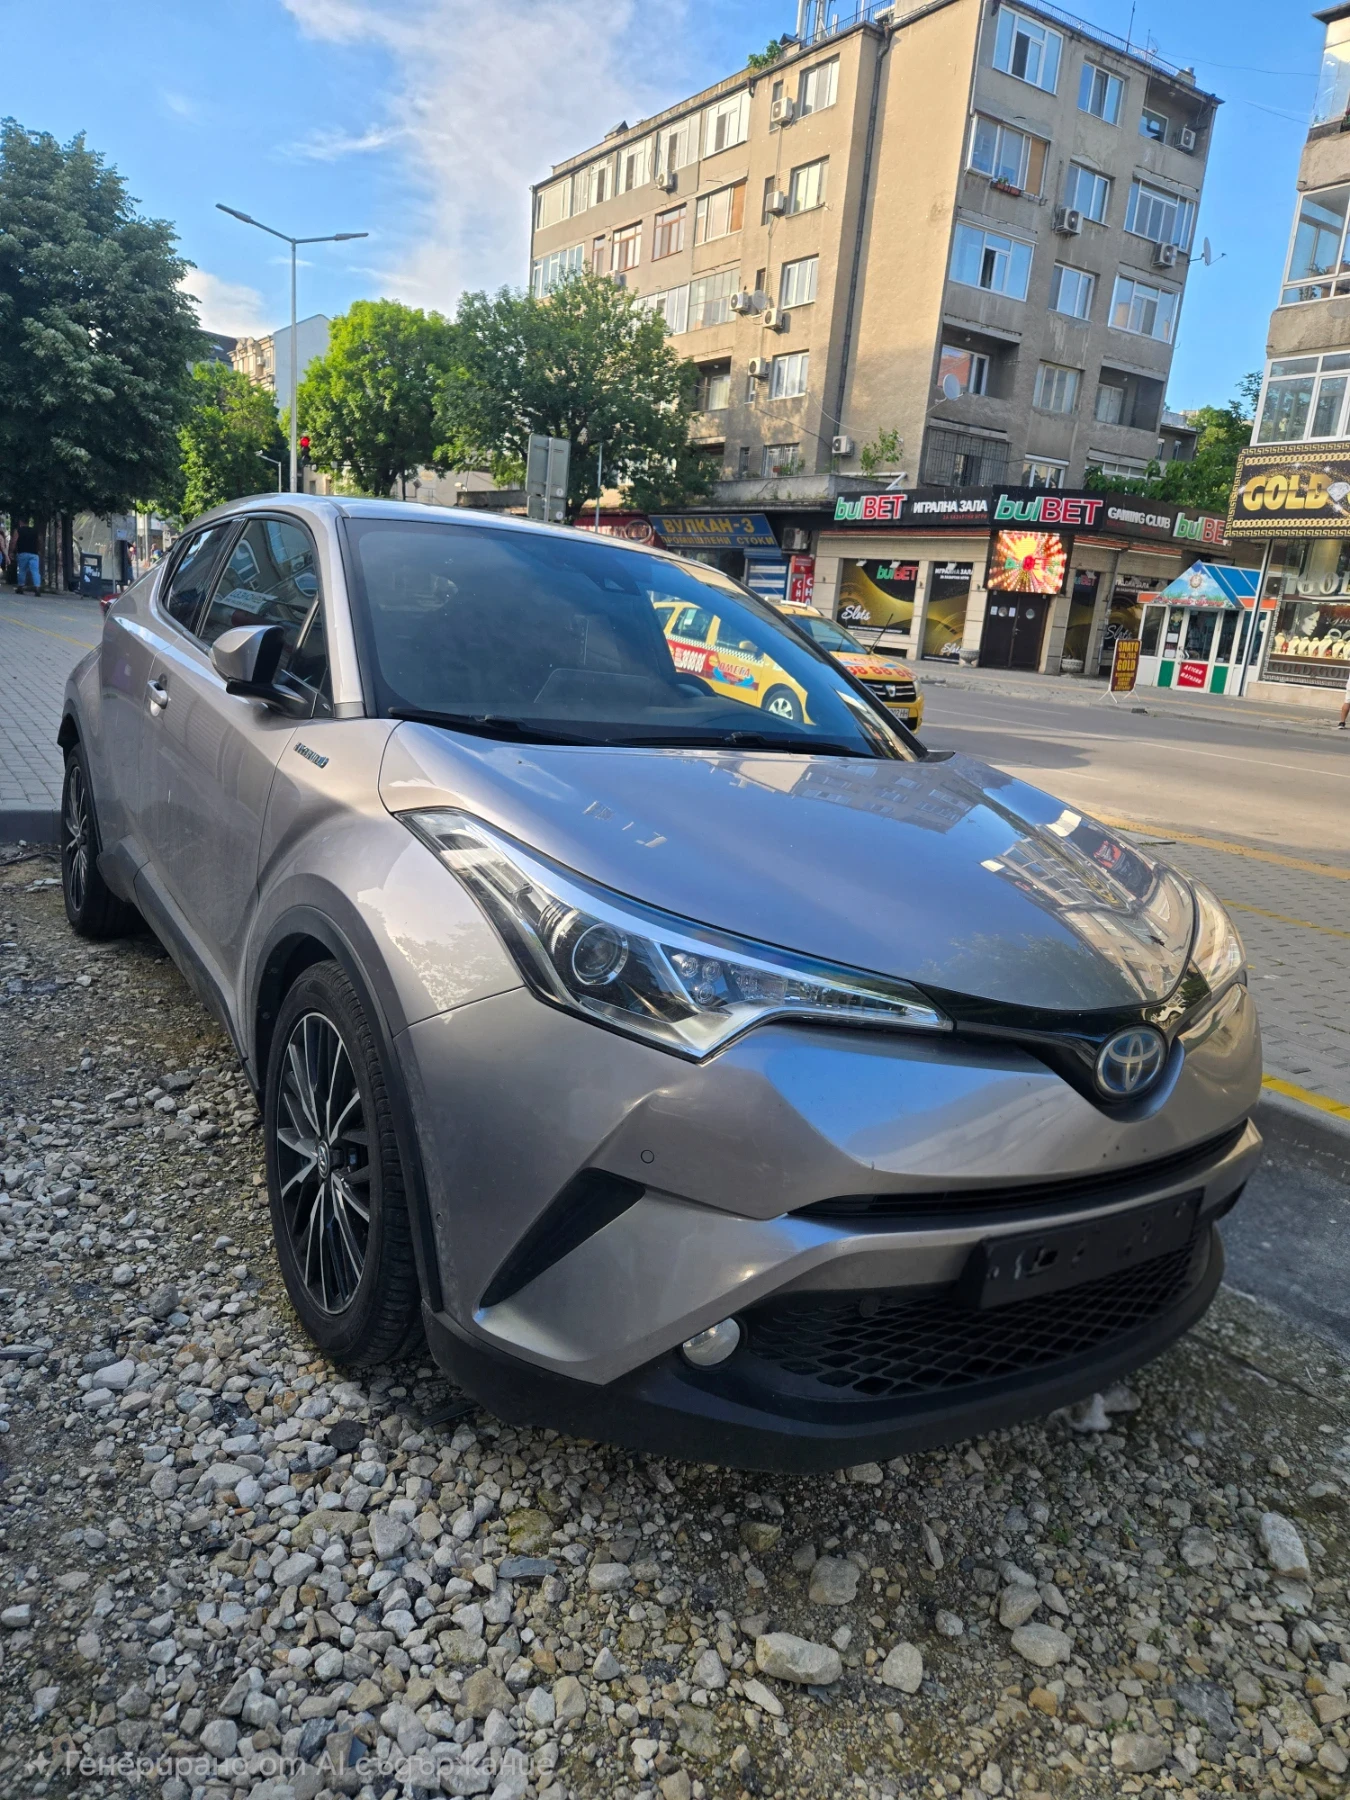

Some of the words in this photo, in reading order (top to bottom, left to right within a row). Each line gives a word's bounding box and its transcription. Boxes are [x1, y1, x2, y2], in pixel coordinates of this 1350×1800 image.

[1243, 473, 1332, 512] GOLD
[834, 494, 908, 521] bulBET
[913, 501, 958, 514] ИГРАЛНА
[958, 499, 988, 512] ЗАЛА
[994, 494, 1104, 525] bulBET
[1107, 507, 1146, 523] GAMING
[1145, 513, 1171, 529] CLUB
[1173, 512, 1232, 547] bulBE
[661, 535, 731, 545] ПРОМИШЛЕНИ
[736, 535, 776, 546] СТОКИ
[876, 565, 919, 581] bulBET
[841, 604, 871, 621] Slots
[1116, 659, 1136, 671] GOLD
